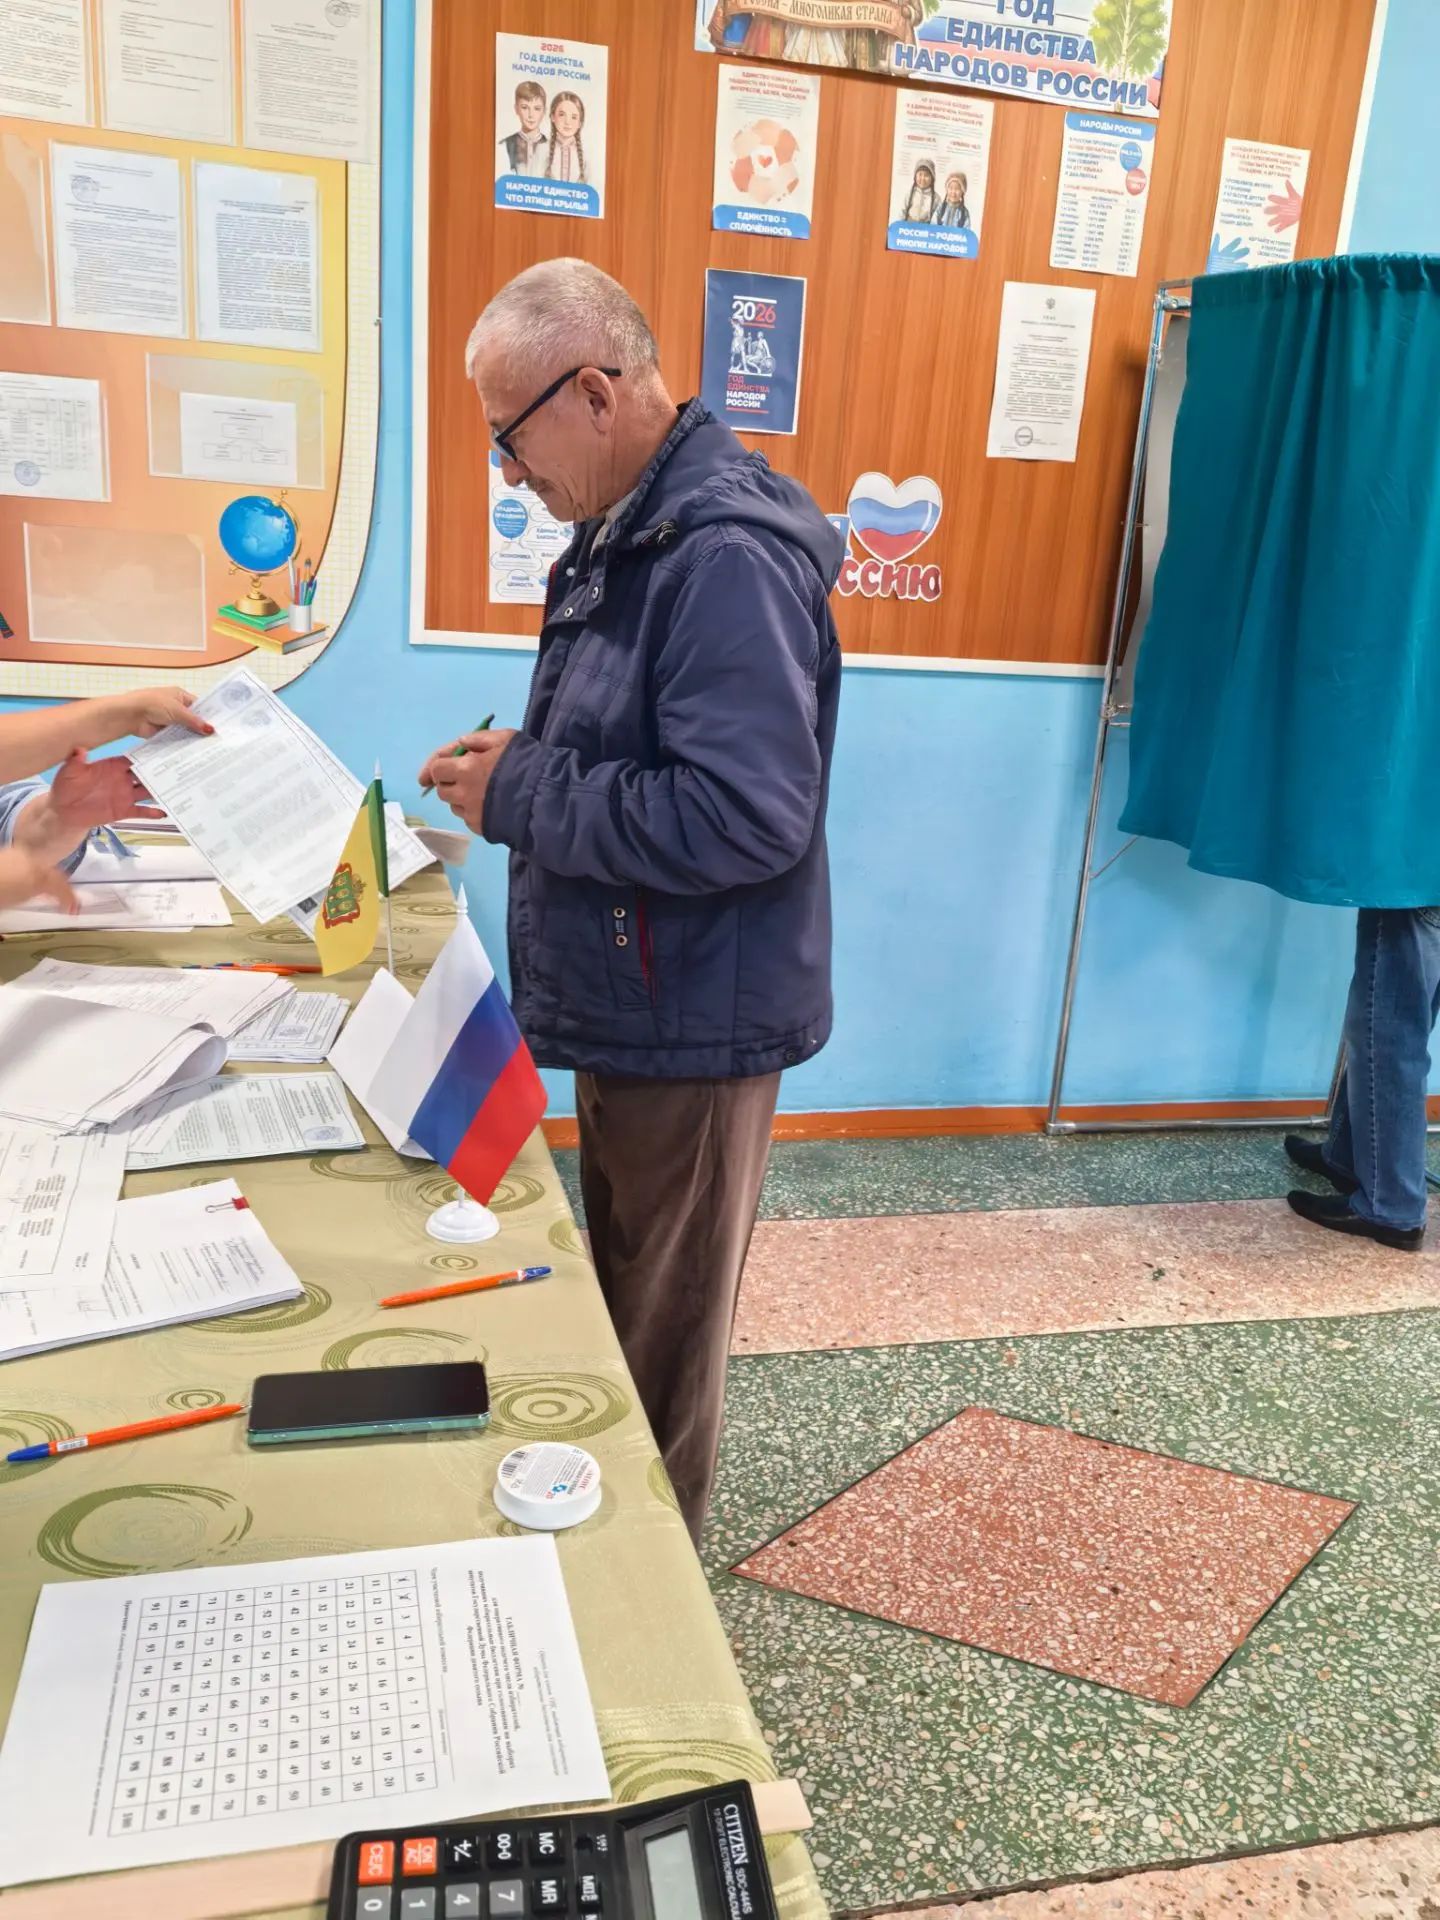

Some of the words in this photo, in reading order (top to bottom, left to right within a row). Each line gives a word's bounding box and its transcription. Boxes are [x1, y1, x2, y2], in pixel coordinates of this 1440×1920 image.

[856, 4, 892, 24] СТРАНА
[947, 18, 1096, 64] ЕДИНСТВА
[519, 52, 537, 62] ГОД
[539, 55, 584, 68] ЕДИНСТВА
[512, 63, 555, 76] НАРОДОВ
[557, 69, 591, 80] РОССИИ
[895, 44, 1028, 87] НАРОДОВ
[1037, 70, 1148, 107] РОССИИ
[1079, 120, 1113, 131] НАРОДЫ
[1114, 125, 1142, 136] РОССИИ
[505, 182, 542, 193] НАРОДУ
[543, 186, 589, 200] ЕДИНСТВО
[505, 193, 523, 203] ЧТО
[736, 211, 780, 223] ЕДИНСТВО
[898, 228, 929, 238] РОССИЯ
[732, 300, 777, 323] 2026
[728, 374, 744, 384] ГОД
[727, 382, 770, 393] ЕДИНСТВА
[726, 391, 766, 401] НАРОДОВ
[726, 398, 761, 409] РОССИИ
[344, 1581, 354, 1590] 21
[370, 1578, 381, 1587] 11
[290, 1588, 300, 1596] 41
[317, 1585, 327, 1593] 31
[234, 1593, 245, 1602] 61
[262, 1590, 273, 1599] 51
[344, 1599, 355, 1609] 22
[371, 1596, 382, 1605] 12
[290, 1606, 300, 1615] 42
[317, 1603, 328, 1612] 32
[233, 1612, 244, 1621] 62
[261, 1609, 272, 1618] 52
[345, 1619, 356, 1629] 23
[373, 1616, 383, 1625] 13
[289, 1626, 300, 1635] 43
[317, 1623, 328, 1632] 33
[232, 1632, 243, 1643] 63
[261, 1629, 272, 1639] 53
[346, 1639, 356, 1649] 24
[374, 1636, 384, 1645] 14
[289, 1647, 299, 1657] 44
[318, 1643, 328, 1653] 34
[231, 1653, 241, 1664] 64
[260, 1650, 271, 1660] 54
[346, 1660, 358, 1670] 25
[375, 1656, 386, 1666] 15
[289, 1669, 299, 1678] 45
[318, 1664, 328, 1674] 35
[230, 1675, 240, 1686] 65
[259, 1672, 270, 1682] 55
[347, 1682, 358, 1692] 26
[377, 1678, 387, 1688] 16
[289, 1691, 299, 1701] 46
[318, 1686, 329, 1696] 36
[259, 1695, 269, 1705] 56
[348, 1705, 360, 1715] 27
[378, 1701, 389, 1711] 17
[288, 1714, 299, 1723] 47
[319, 1709, 330, 1719] 37
[257, 1718, 269, 1728] 57
[349, 1729, 360, 1740] 28
[380, 1726, 391, 1736] 18
[288, 1739, 299, 1749] 48
[319, 1734, 330, 1745] 38
[257, 1743, 268, 1754] 58
[350, 1754, 362, 1766] 29
[381, 1751, 392, 1761] 19
[288, 1764, 299, 1775] 49
[320, 1759, 330, 1770] 39
[256, 1768, 268, 1779] 59
[414, 1771, 425, 1783] 10
[351, 1780, 363, 1792] 30
[383, 1776, 394, 1787] 20
[320, 1785, 331, 1796] 40
[723, 1803, 749, 1865] CITIZEN
[539, 1832, 556, 1854] MC
[406, 1847, 418, 1864] AC
[421, 1845, 433, 1864] ON
[497, 1889, 516, 1902] 7
[541, 1880, 557, 1904] MR
[735, 1867, 753, 1914] SDC-444S
[408, 1899, 426, 1908] 1
[453, 1893, 471, 1906] 4
[363, 1898, 383, 1912] 0
